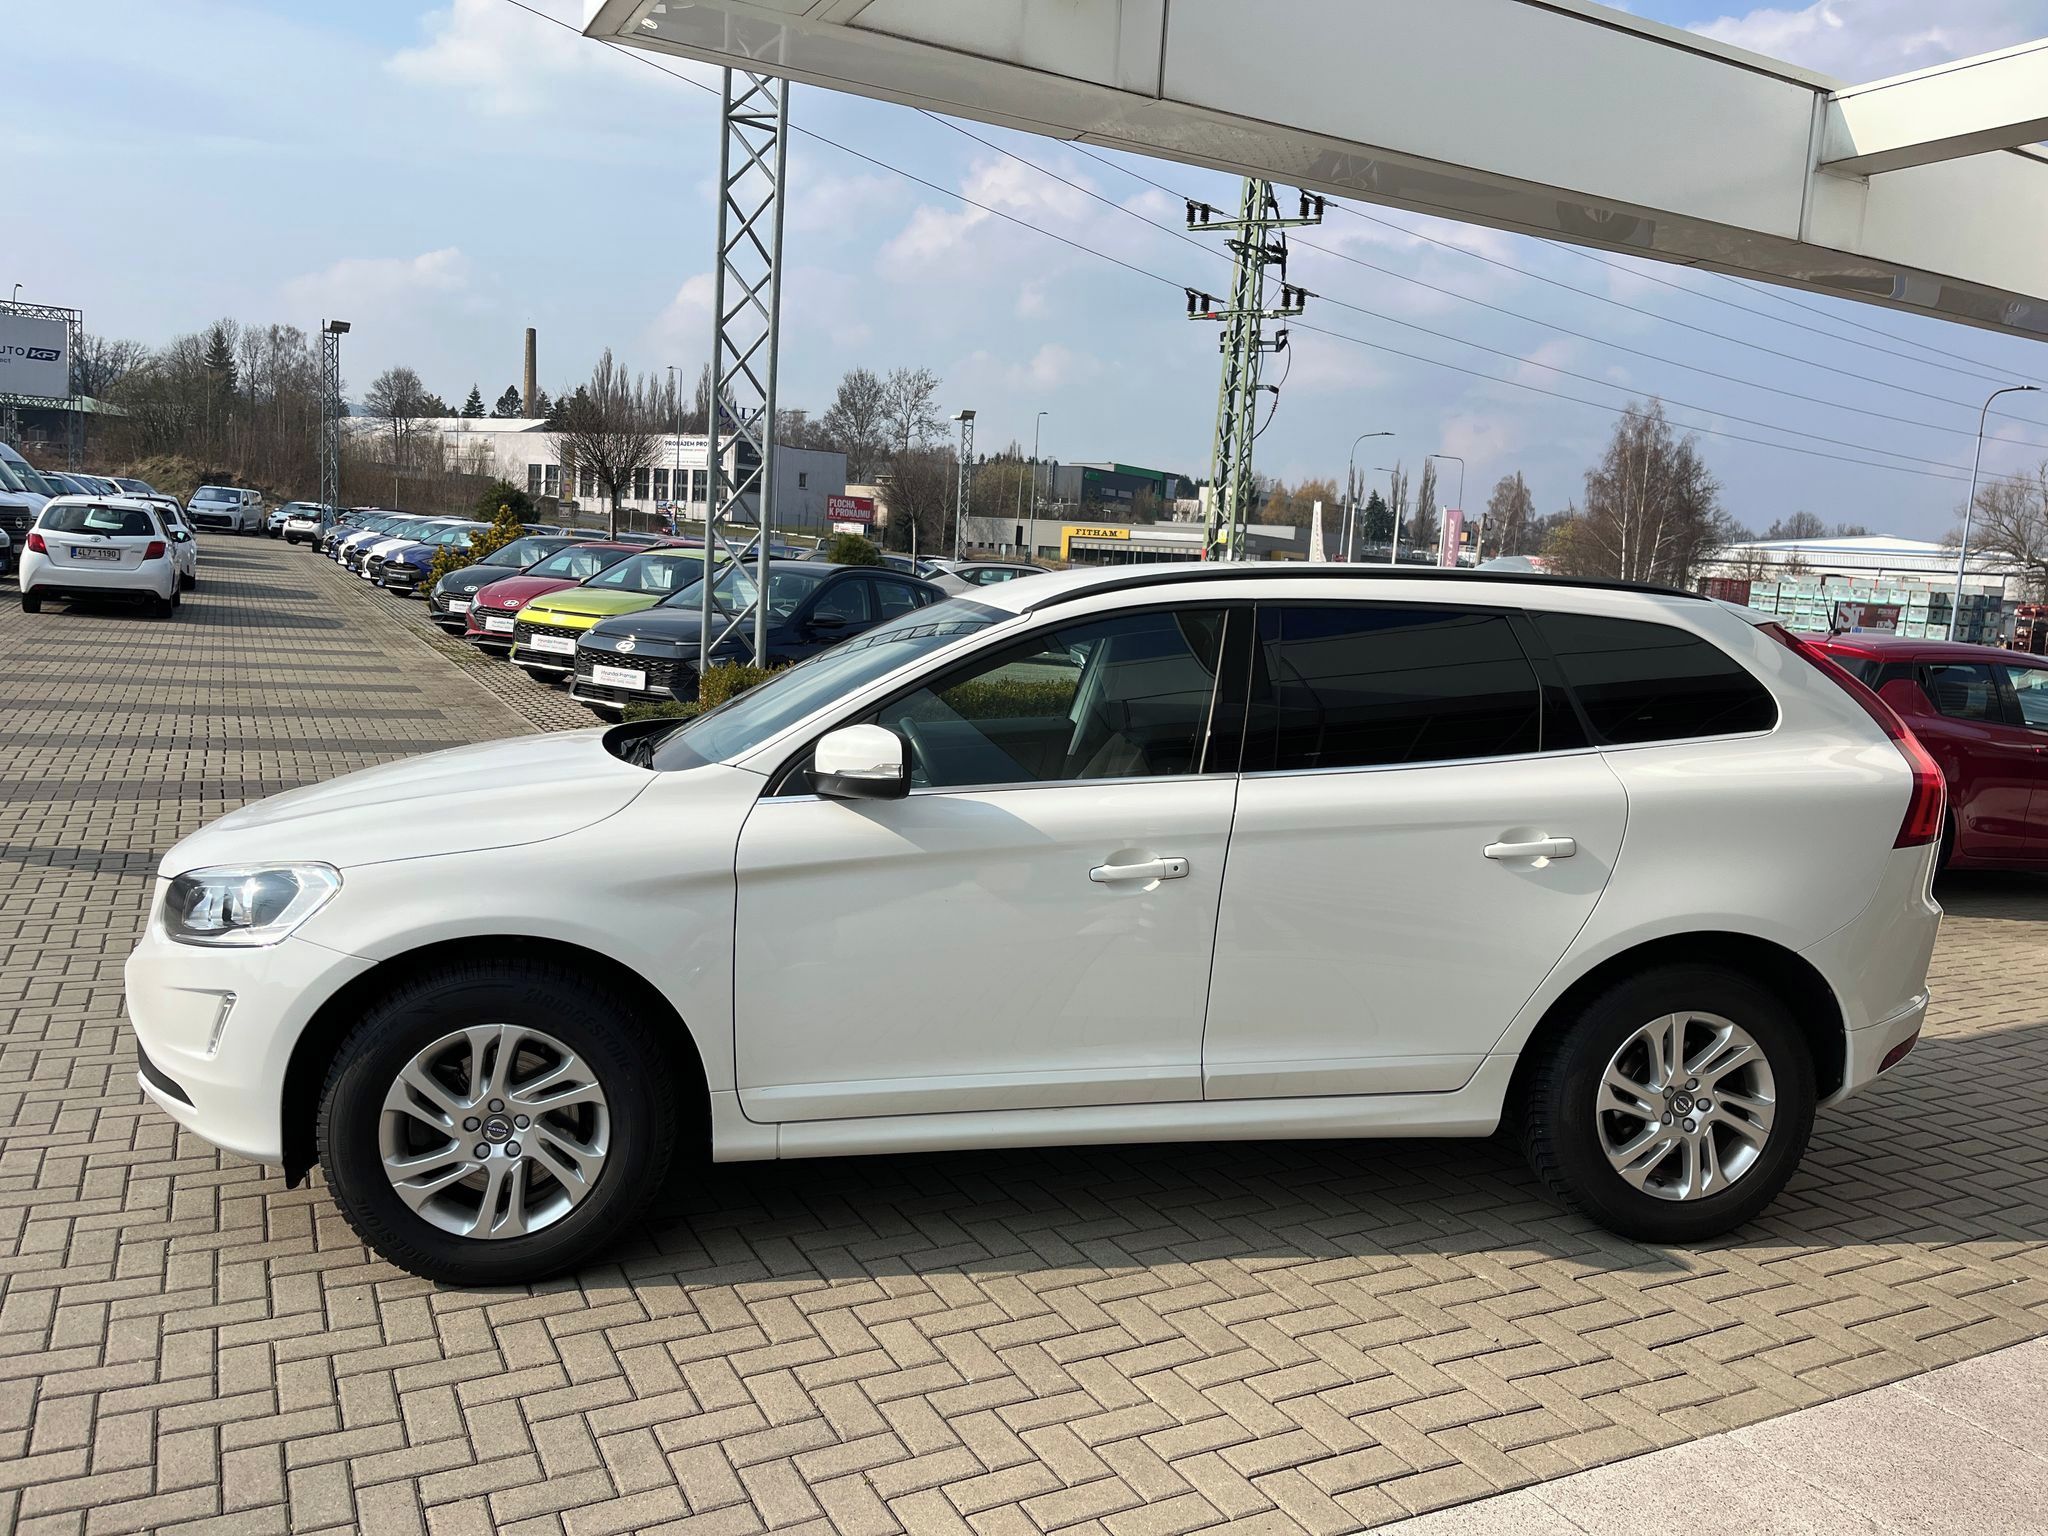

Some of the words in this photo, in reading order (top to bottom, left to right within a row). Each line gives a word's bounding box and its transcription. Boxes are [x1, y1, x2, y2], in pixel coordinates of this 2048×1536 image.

[829, 498, 857, 509] PLOCHA
[1076, 529, 1118, 537] FITHAM
[77, 548, 93, 557] 4L7
[98, 549, 117, 558] 1190
